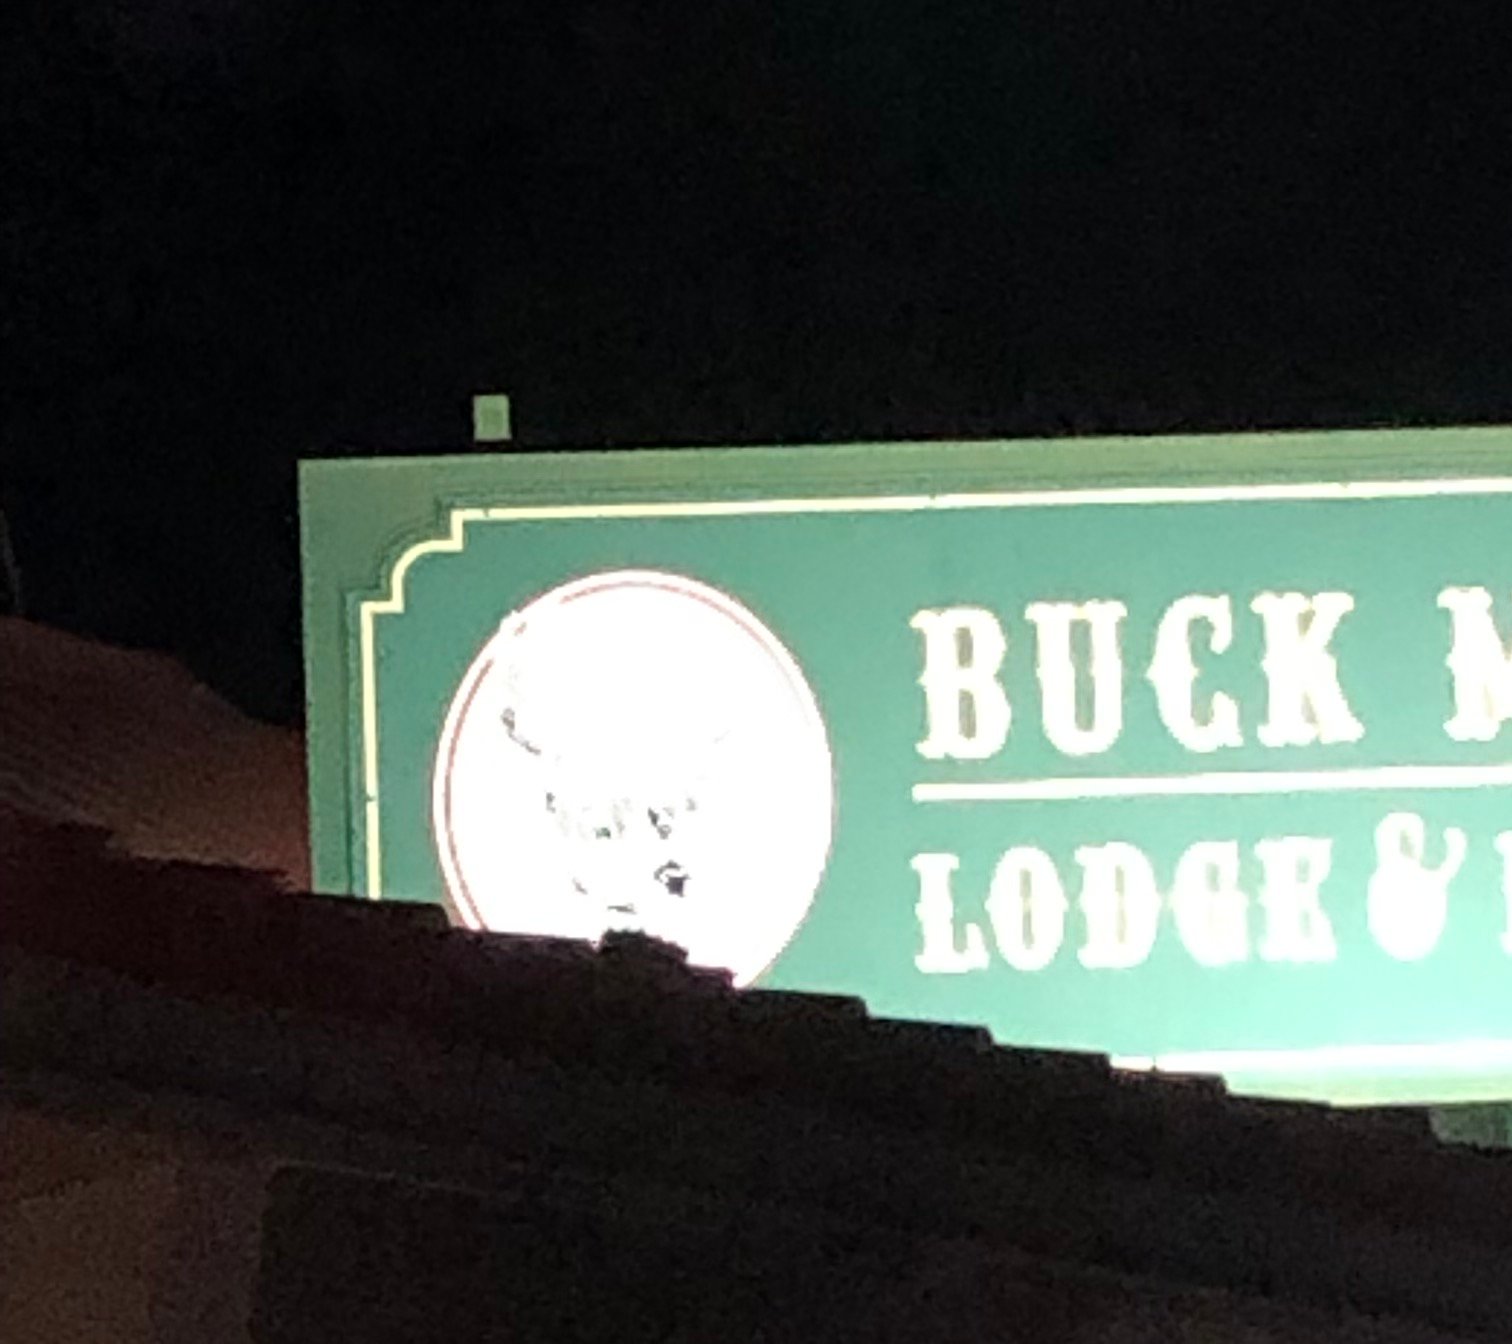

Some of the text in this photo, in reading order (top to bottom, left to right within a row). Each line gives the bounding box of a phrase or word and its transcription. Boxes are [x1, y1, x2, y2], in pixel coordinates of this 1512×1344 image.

[910, 589, 1364, 762] BUCK
[912, 836, 1340, 975] LODGE
[1368, 810, 1467, 961] &
